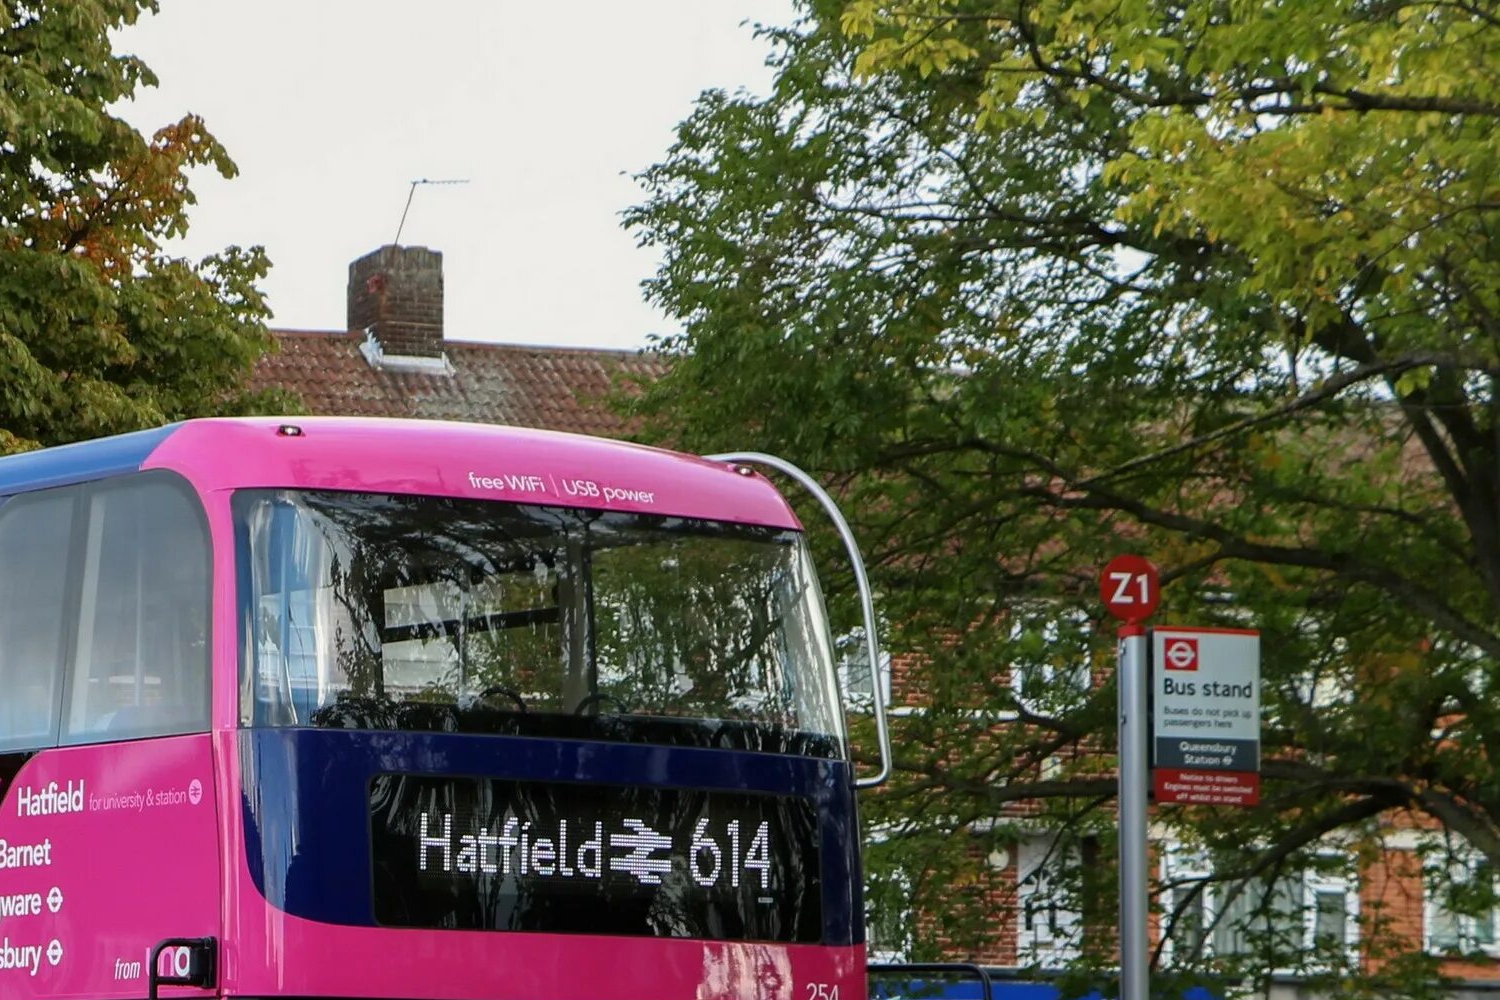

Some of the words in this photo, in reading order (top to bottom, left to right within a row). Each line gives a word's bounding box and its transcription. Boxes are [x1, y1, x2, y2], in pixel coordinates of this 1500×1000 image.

[468, 472, 504, 489] free
[504, 474, 546, 492] WiFi
[562, 479, 600, 497] USB
[603, 487, 654, 503] power
[1109, 572, 1149, 604] Z1
[1164, 678, 1196, 696] Bus
[1202, 680, 1252, 698] stand
[1164, 705, 1189, 715] Buses
[1192, 706, 1203, 716] do
[1206, 708, 1220, 716] not
[1223, 708, 1239, 719] pick
[1242, 710, 1253, 719] up
[1163, 720, 1211, 729] passengers
[1214, 719, 1233, 728] here
[1179, 741, 1237, 755] Queensbury
[1184, 754, 1221, 765] Station
[17, 779, 84, 817] Hatfield
[89, 793, 100, 811] for
[103, 791, 144, 812] university
[145, 788, 154, 807] &
[155, 787, 187, 806] station
[419, 812, 602, 878] Hatfield
[690, 818, 770, 888] 614
[114, 957, 140, 980] from
